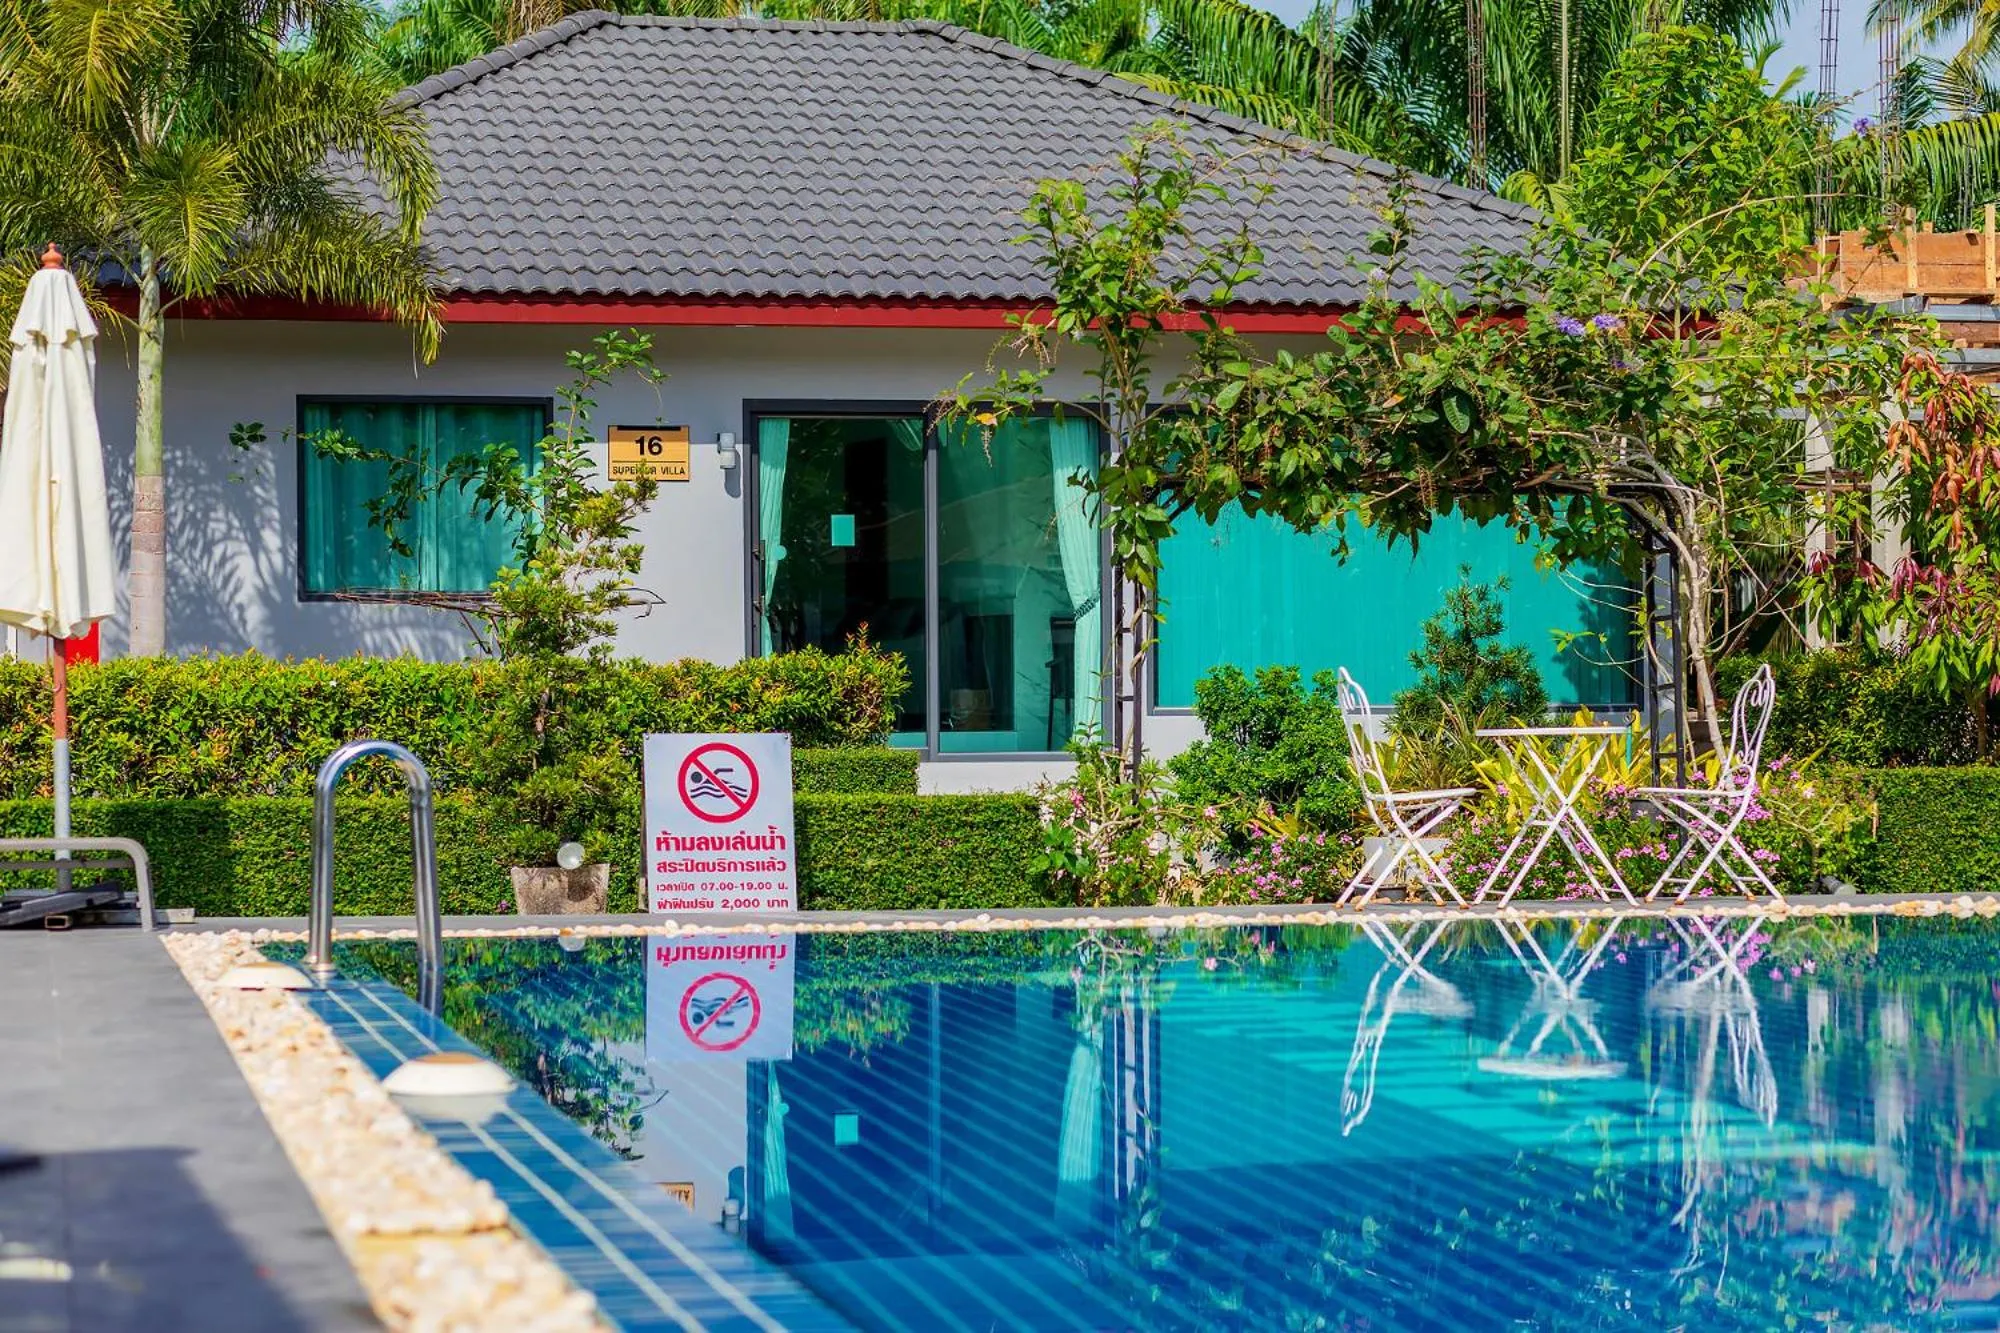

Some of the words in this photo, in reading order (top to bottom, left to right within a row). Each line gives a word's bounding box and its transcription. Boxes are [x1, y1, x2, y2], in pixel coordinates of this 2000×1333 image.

[634, 436, 663, 456] 16
[661, 466, 686, 475] VILLA
[656, 825, 786, 851] ห้ามลงเล่นน้ำ
[656, 857, 787, 873] สระปิดบริการแล้ว
[656, 882, 695, 892] เวลาเปิด
[700, 882, 773, 891] 07.00-19.00
[657, 898, 714, 910] ฝ่าฝืนปรับ
[721, 898, 761, 910] 2,000
[767, 899, 789, 908] บาท
